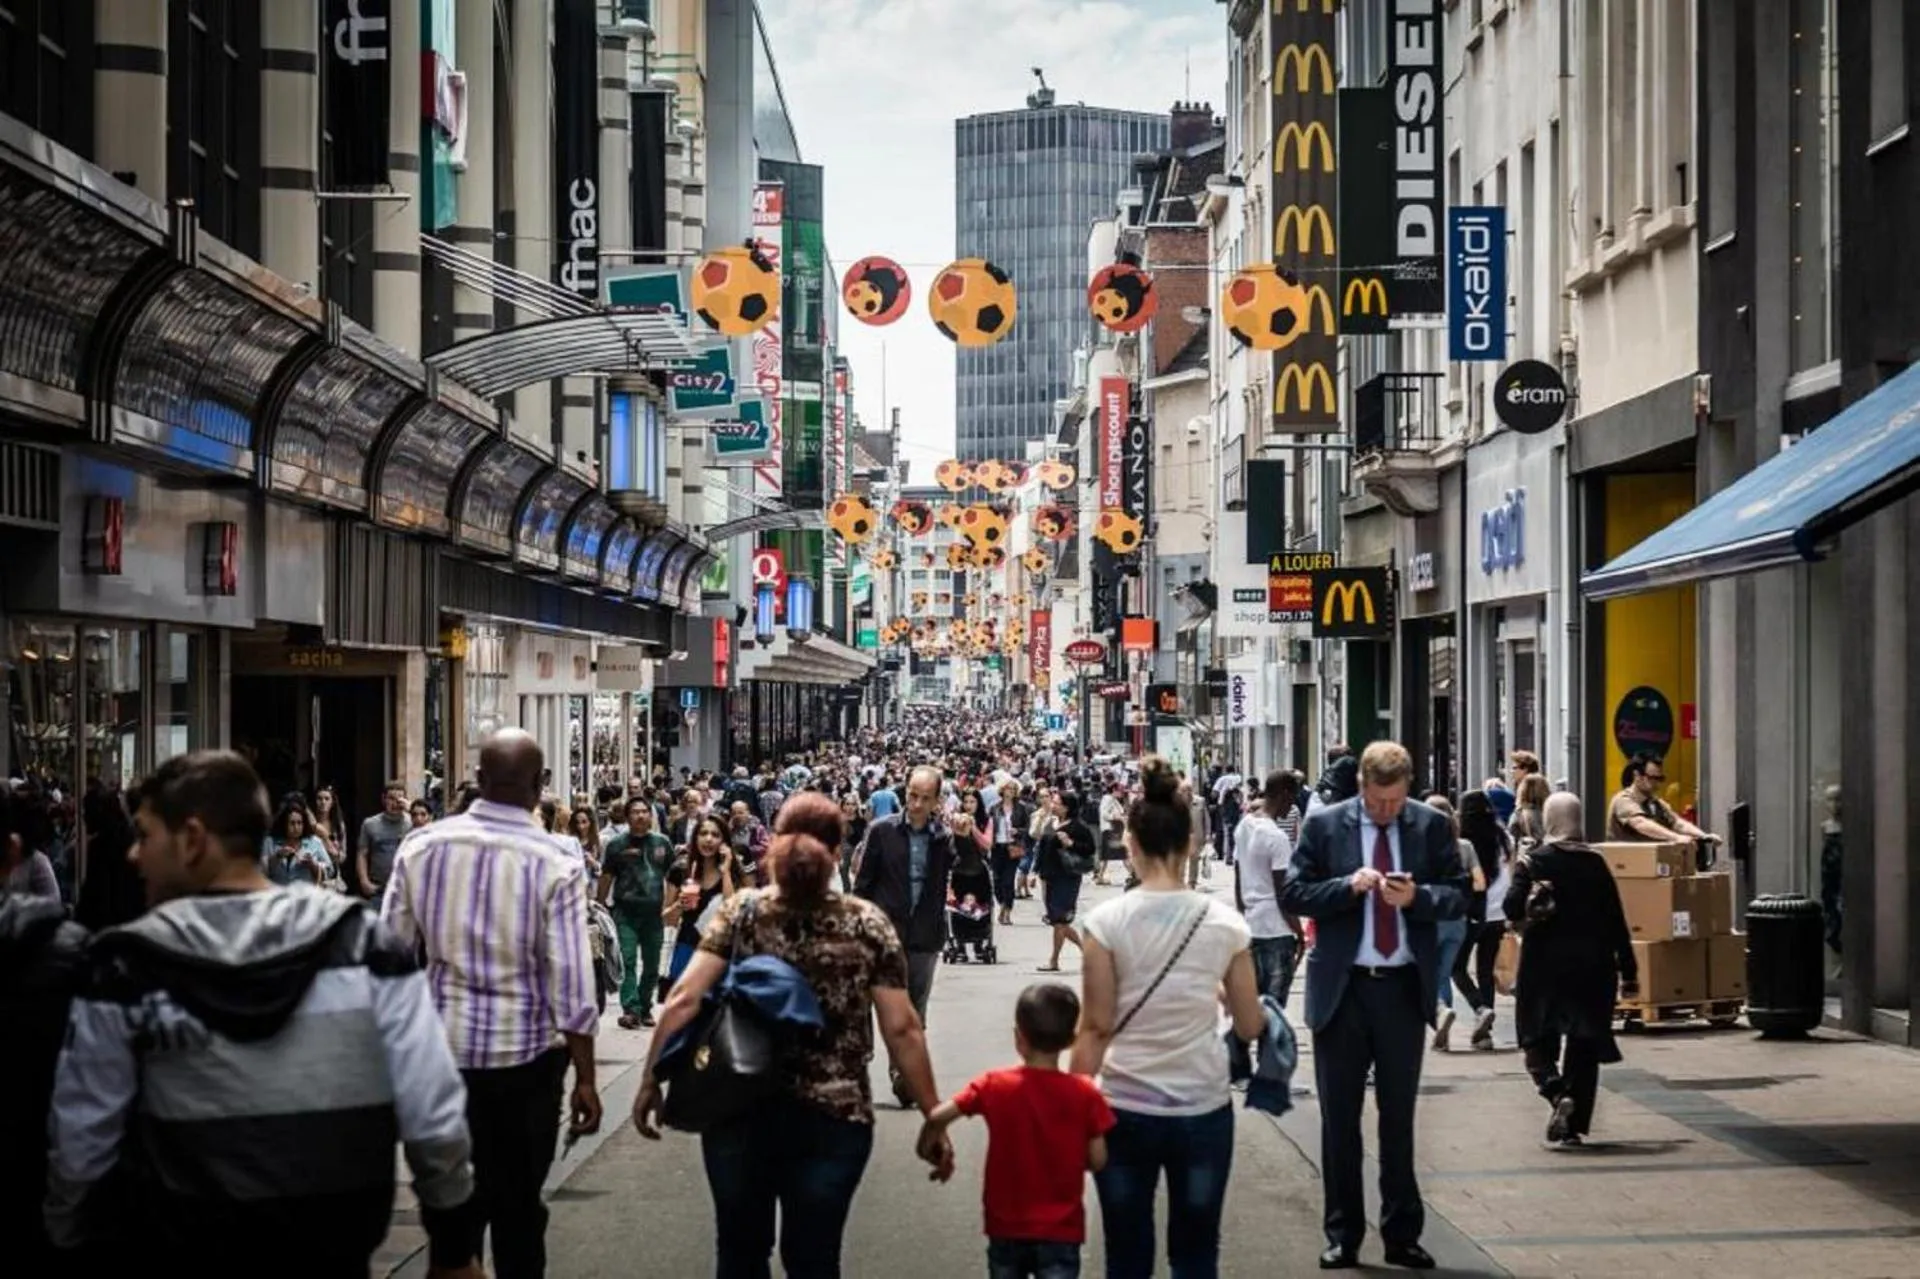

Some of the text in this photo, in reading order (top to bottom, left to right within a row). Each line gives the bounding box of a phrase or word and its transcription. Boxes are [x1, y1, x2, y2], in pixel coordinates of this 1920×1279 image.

[562, 178, 596, 292] fnac
[1457, 216, 1491, 351] okaïdi
[1506, 381, 1565, 405] éram
[1271, 553, 1333, 571] A LOUER
